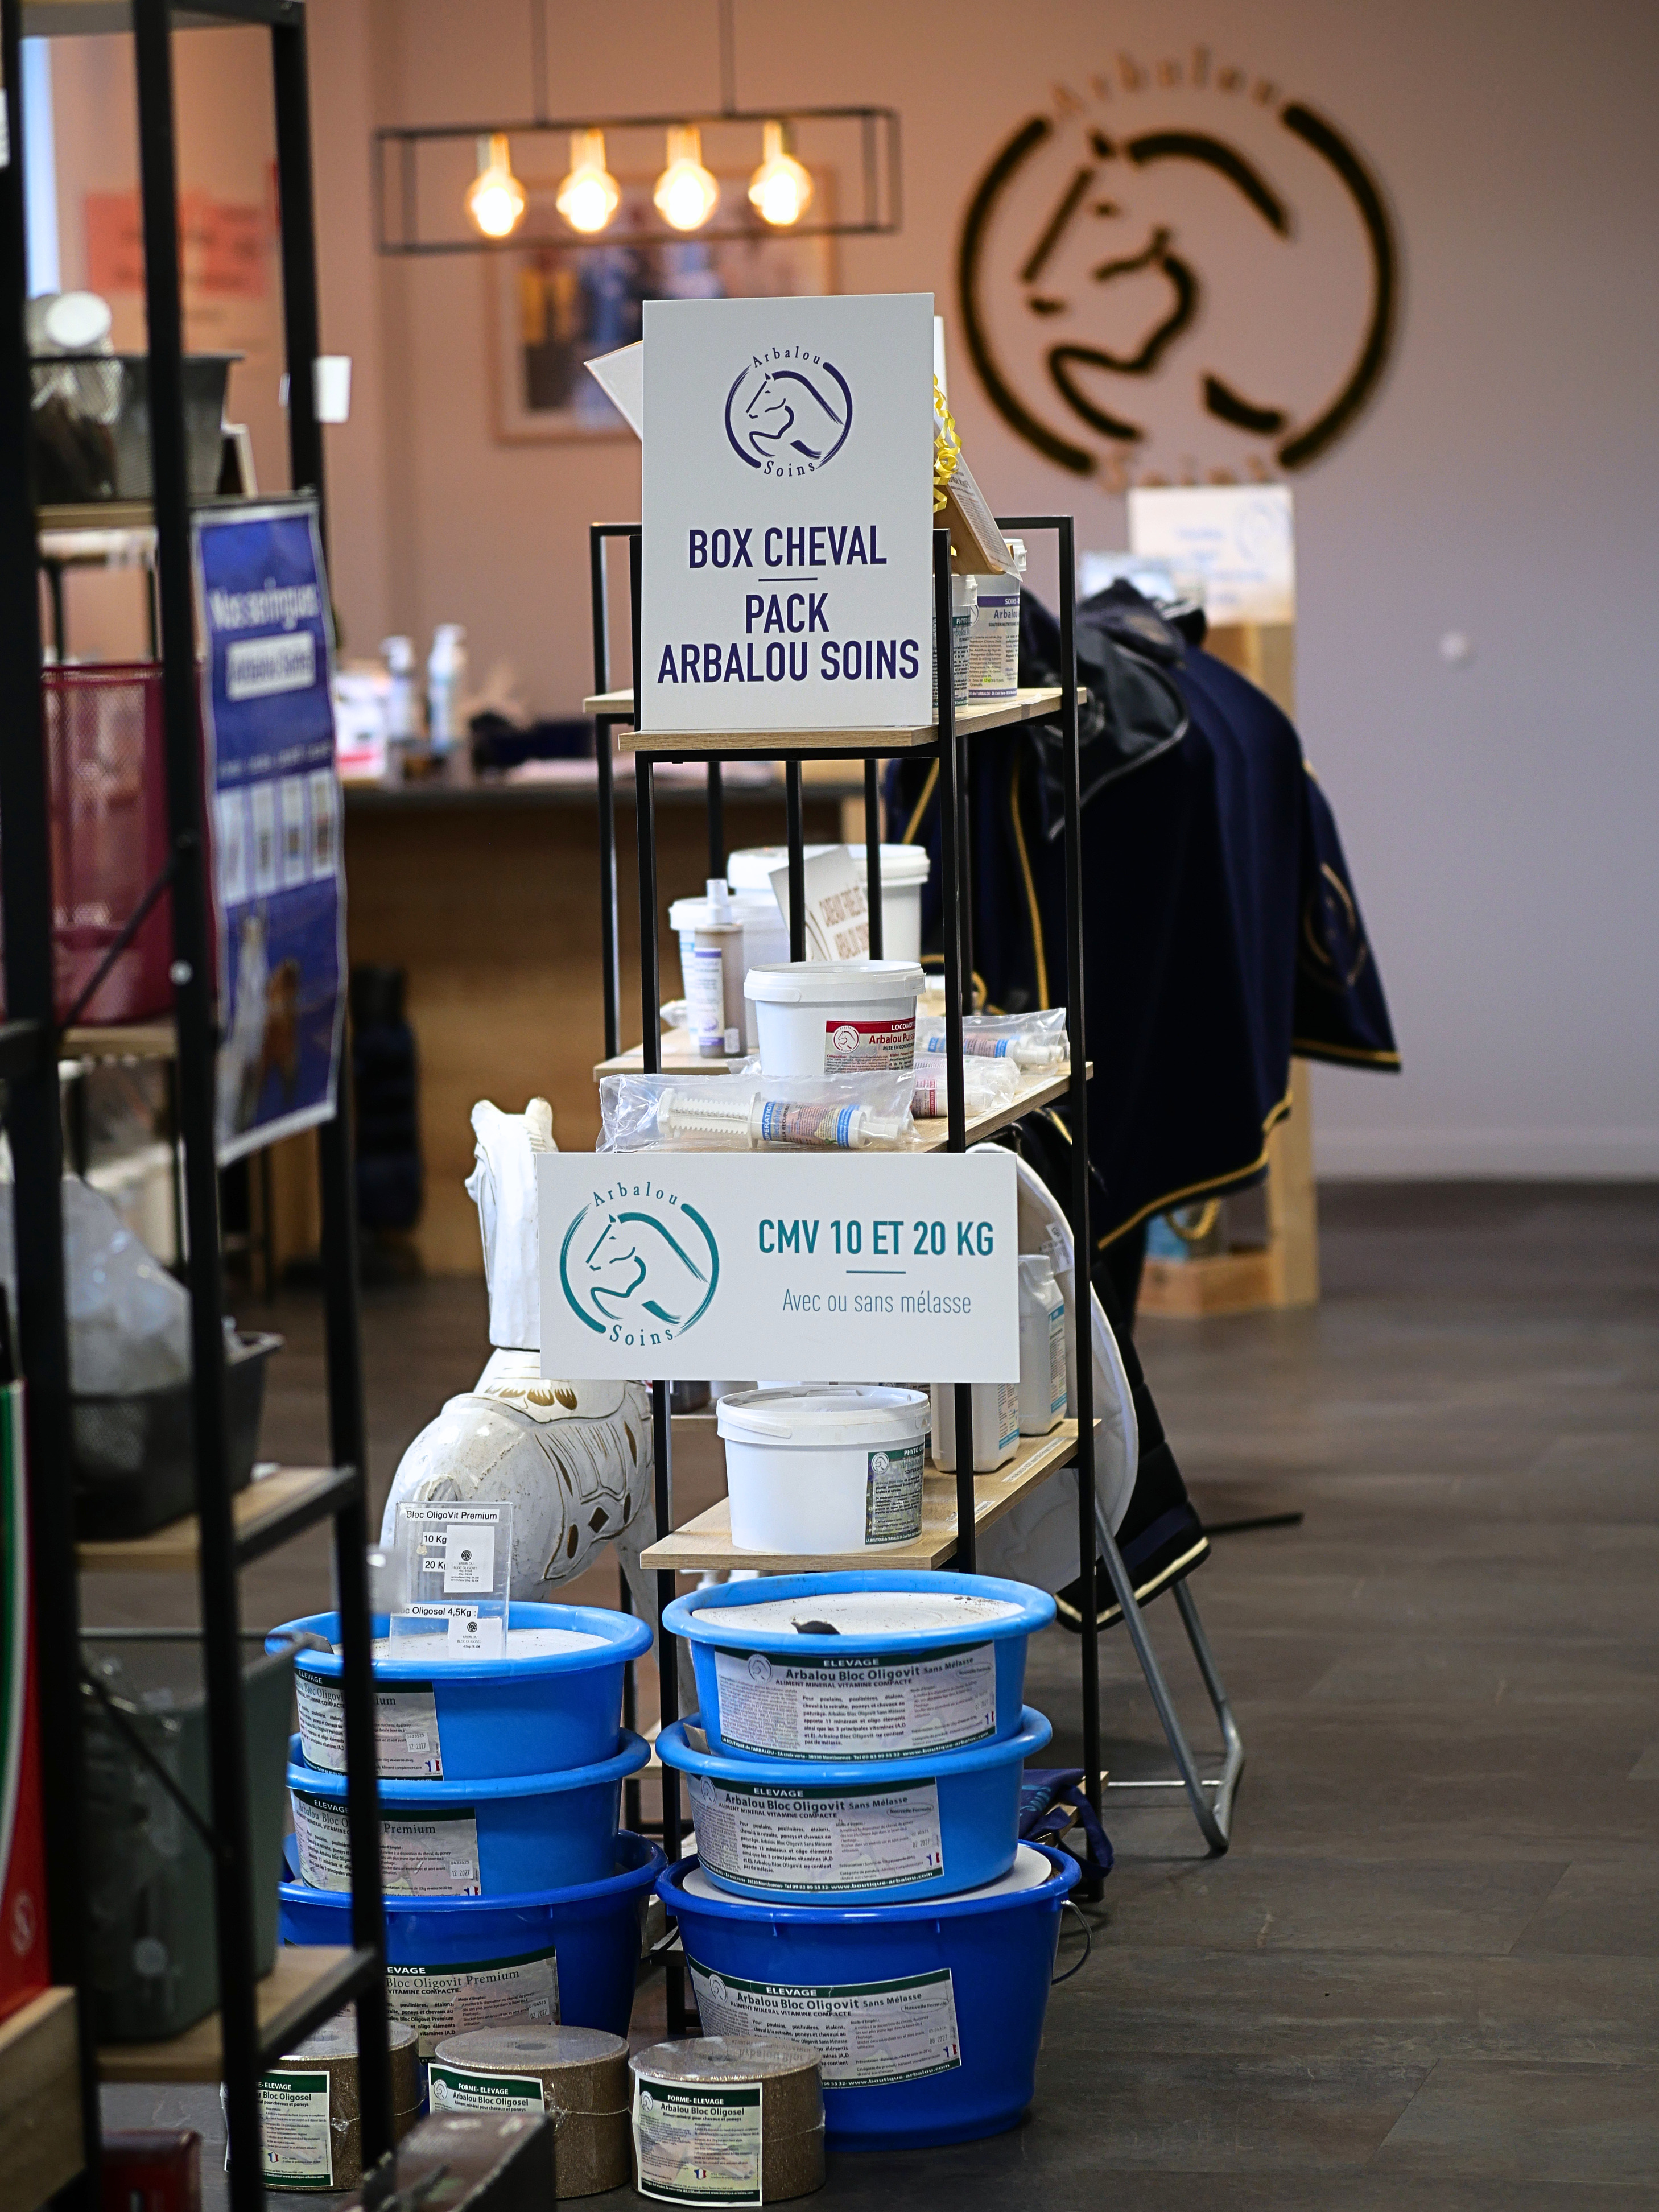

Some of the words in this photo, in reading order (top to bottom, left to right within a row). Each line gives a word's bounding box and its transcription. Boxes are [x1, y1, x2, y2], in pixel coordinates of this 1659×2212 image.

[753, 346, 820, 369] Arbalou
[764, 460, 815, 477] Soins
[689, 529, 752, 568] BOX
[764, 526, 887, 567] CHEVAL
[746, 593, 829, 633] PACK
[658, 642, 807, 683] ARBALOU
[820, 639, 919, 680] SOINS
[869, 1034, 901, 1044] Arbalou
[592, 1182, 678, 1207] Arbalou
[759, 1220, 819, 1254] CMV
[831, 1220, 862, 1254] 10
[873, 1221, 903, 1254] ET
[913, 1221, 945, 1256] 20
[957, 1221, 993, 1256] KG
[783, 1288, 820, 1311] Avec
[828, 1295, 847, 1312] ou
[855, 1295, 893, 1313] sans
[901, 1290, 971, 1314] mélasse
[609, 1324, 673, 1346] Soins
[904, 1447, 918, 1456] PHYTO
[427, 1511, 459, 1521] OligoVit
[436, 1536, 447, 1544] Kg
[412, 1607, 445, 1616] Oligosel
[448, 1608, 471, 1617] 4,5Kg
[786, 1669, 835, 1681] Arbalou
[839, 1670, 864, 1681] Bloc
[868, 1666, 919, 1682] Oligovit
[945, 1657, 973, 1669] Mélasse
[824, 1658, 880, 1667] ELEVAGE
[299, 1671, 323, 1684] ELEVAGE
[874, 1678, 912, 1687] COMPACTE
[304, 1683, 316, 1695] Bloc
[317, 1687, 344, 1702] Oligovi
[754, 1788, 804, 1797] ELEVAGE
[719, 1803, 740, 1812] ALIMENT
[741, 1807, 765, 1816] MINERAL
[725, 1794, 765, 1809] Arbalou
[768, 1801, 790, 1810] Bloc
[793, 1800, 845, 1814] Oligovit
[873, 1797, 907, 1807] Mélasse
[322, 1814, 339, 1825] Bloc
[384, 1823, 436, 1834] Premium
[324, 1824, 346, 1834] VITAMINE
[831, 1872, 932, 1889] www.boutique-arbalou.com
[386, 1977, 410, 1987] Bloc
[414, 1977, 461, 1990] Oligovit
[467, 1970, 519, 1985] Premium
[766, 1987, 817, 1996] ELEVAGE
[731, 2001, 753, 2011] ALIMENT
[737, 1992, 778, 2008] Arbalou
[781, 1999, 804, 2009] Bloc
[807, 1999, 859, 2012] Oligovit
[887, 1993, 922, 2004] Mélasse
[849, 2064, 950, 2085] www.boutique-arbalou.com
[459, 2083, 480, 2092] FORME-
[280, 2093, 312, 2102] Oligosel
[453, 2091, 477, 2102] Arbalou
[667, 2095, 692, 2103] FORME-
[661, 2103, 689, 2113] Arbalou
[711, 2107, 744, 2117] Oligosel
